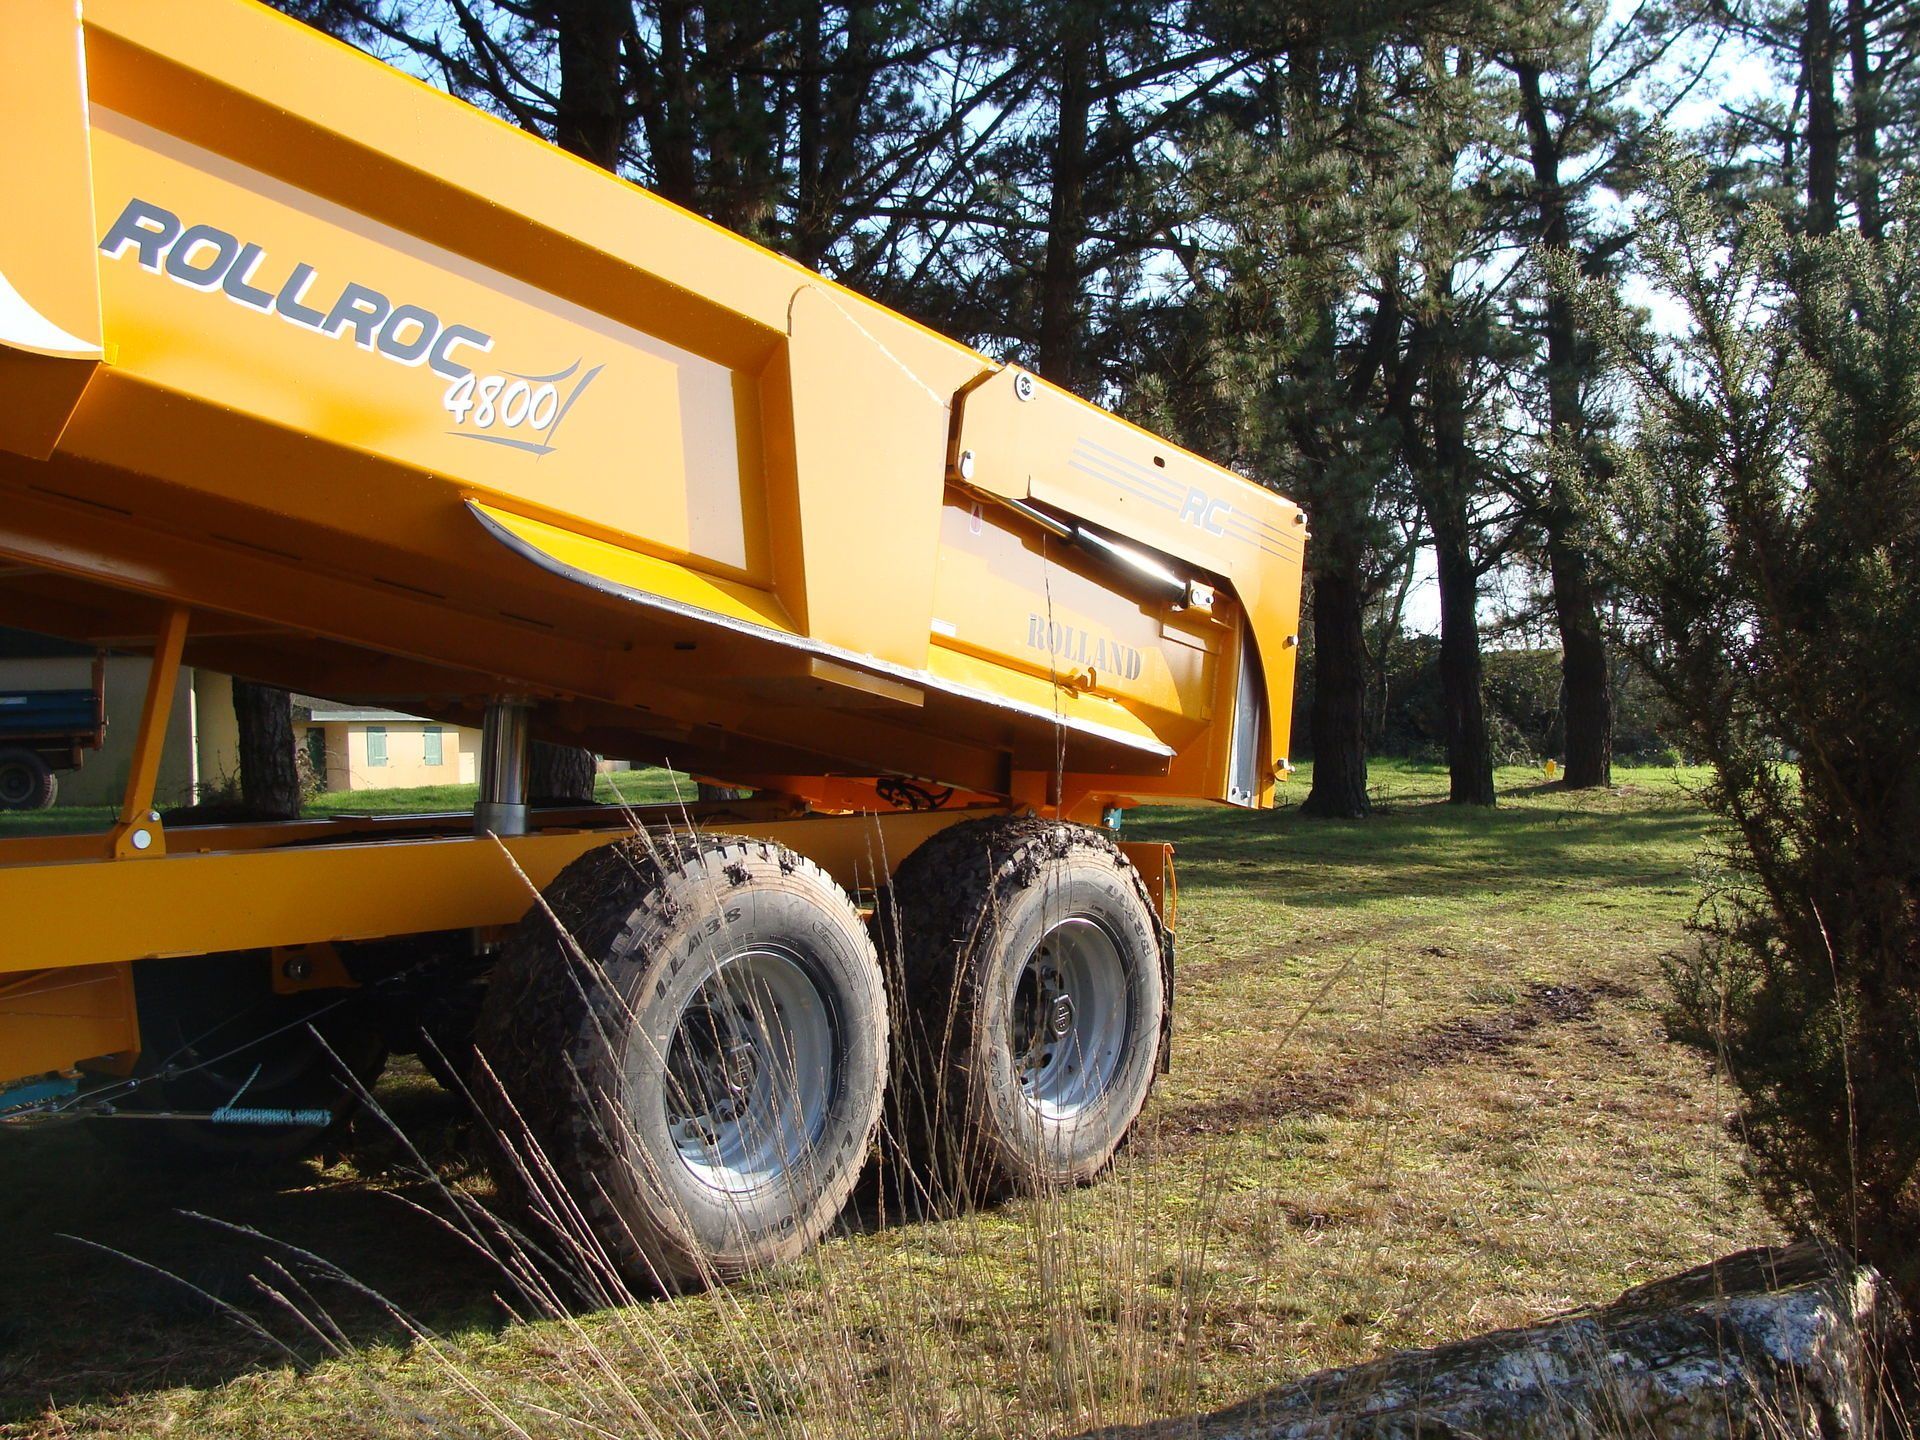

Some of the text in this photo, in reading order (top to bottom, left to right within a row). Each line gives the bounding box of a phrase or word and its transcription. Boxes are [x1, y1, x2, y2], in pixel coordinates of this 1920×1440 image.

[98, 198, 494, 380] ROLLROC
[444, 373, 559, 430] 4800
[1179, 485, 1232, 538] RC
[1027, 613, 1141, 681] ROLLAND
